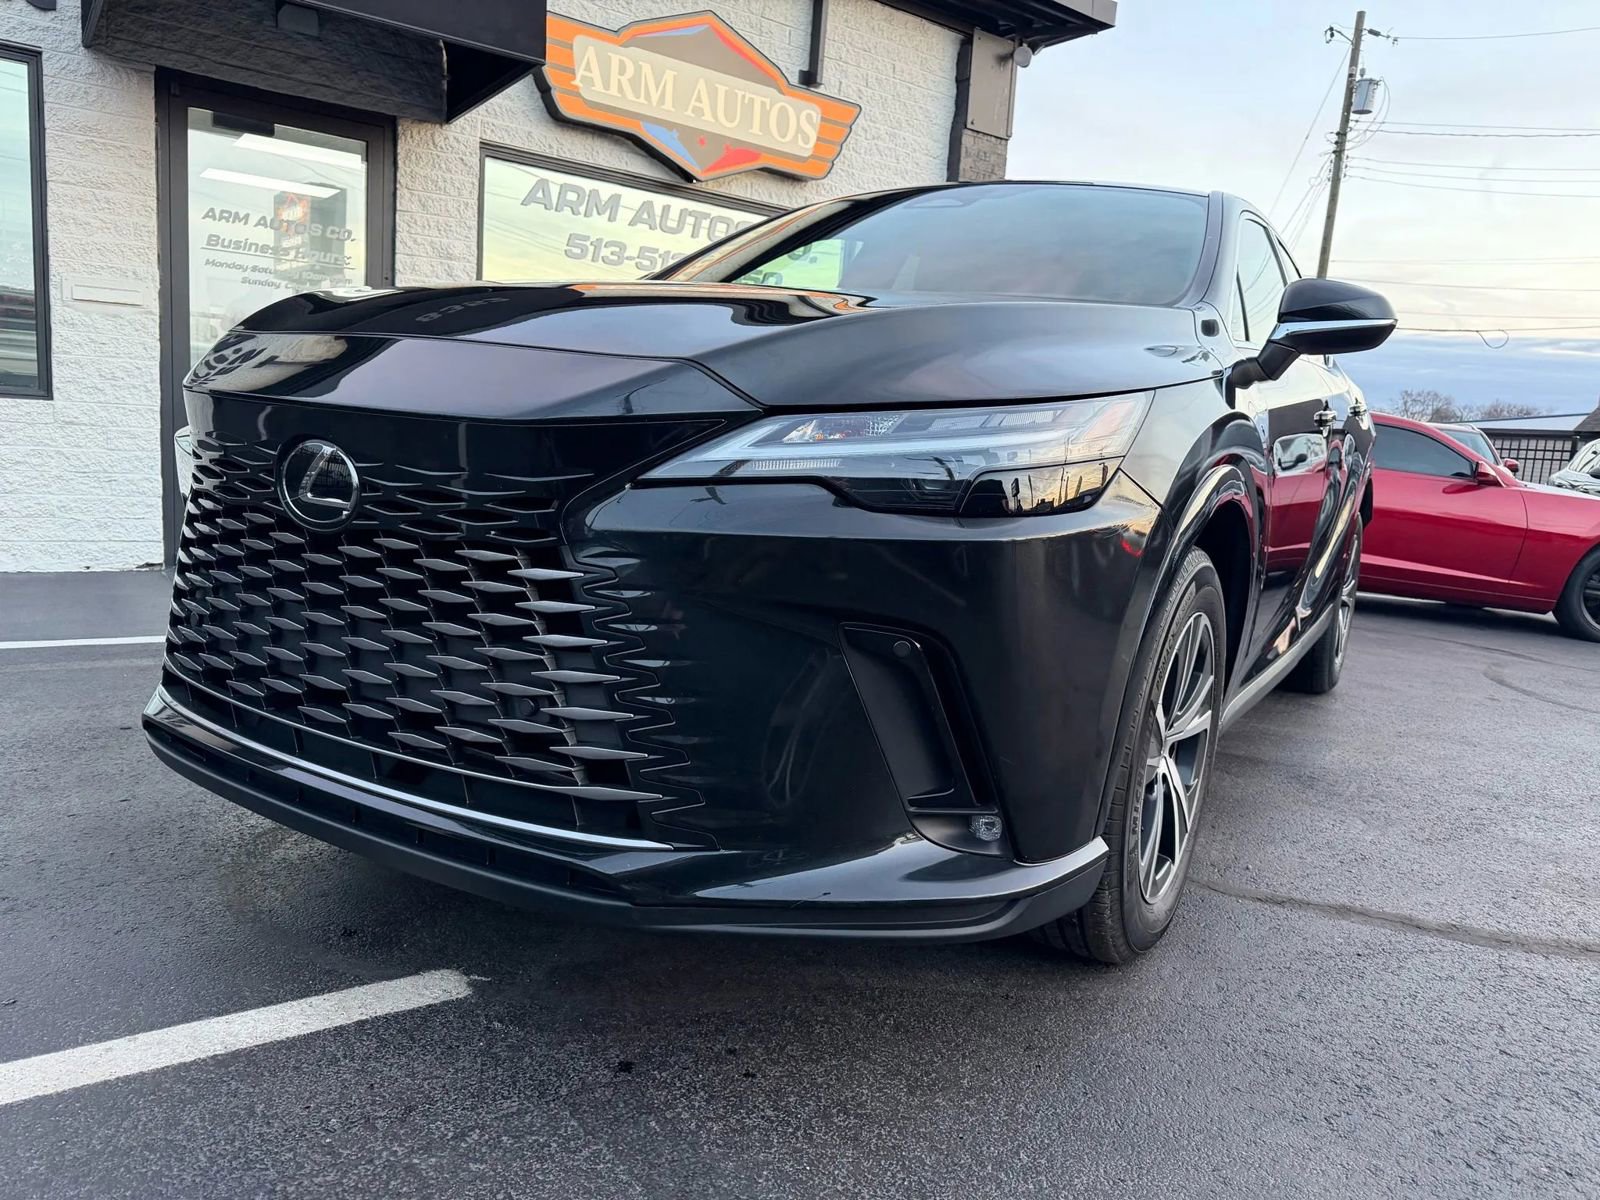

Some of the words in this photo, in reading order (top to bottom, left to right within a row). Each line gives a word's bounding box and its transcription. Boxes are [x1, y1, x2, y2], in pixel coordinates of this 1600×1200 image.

[571, 45, 677, 111] ARM
[684, 78, 820, 149] AUTOS
[520, 178, 622, 222] ARM
[201, 207, 250, 226] ARM
[253, 215, 323, 237] AUTOS
[326, 226, 356, 242] CO.
[206, 233, 290, 257] Business
[241, 276, 280, 290] Sunday
